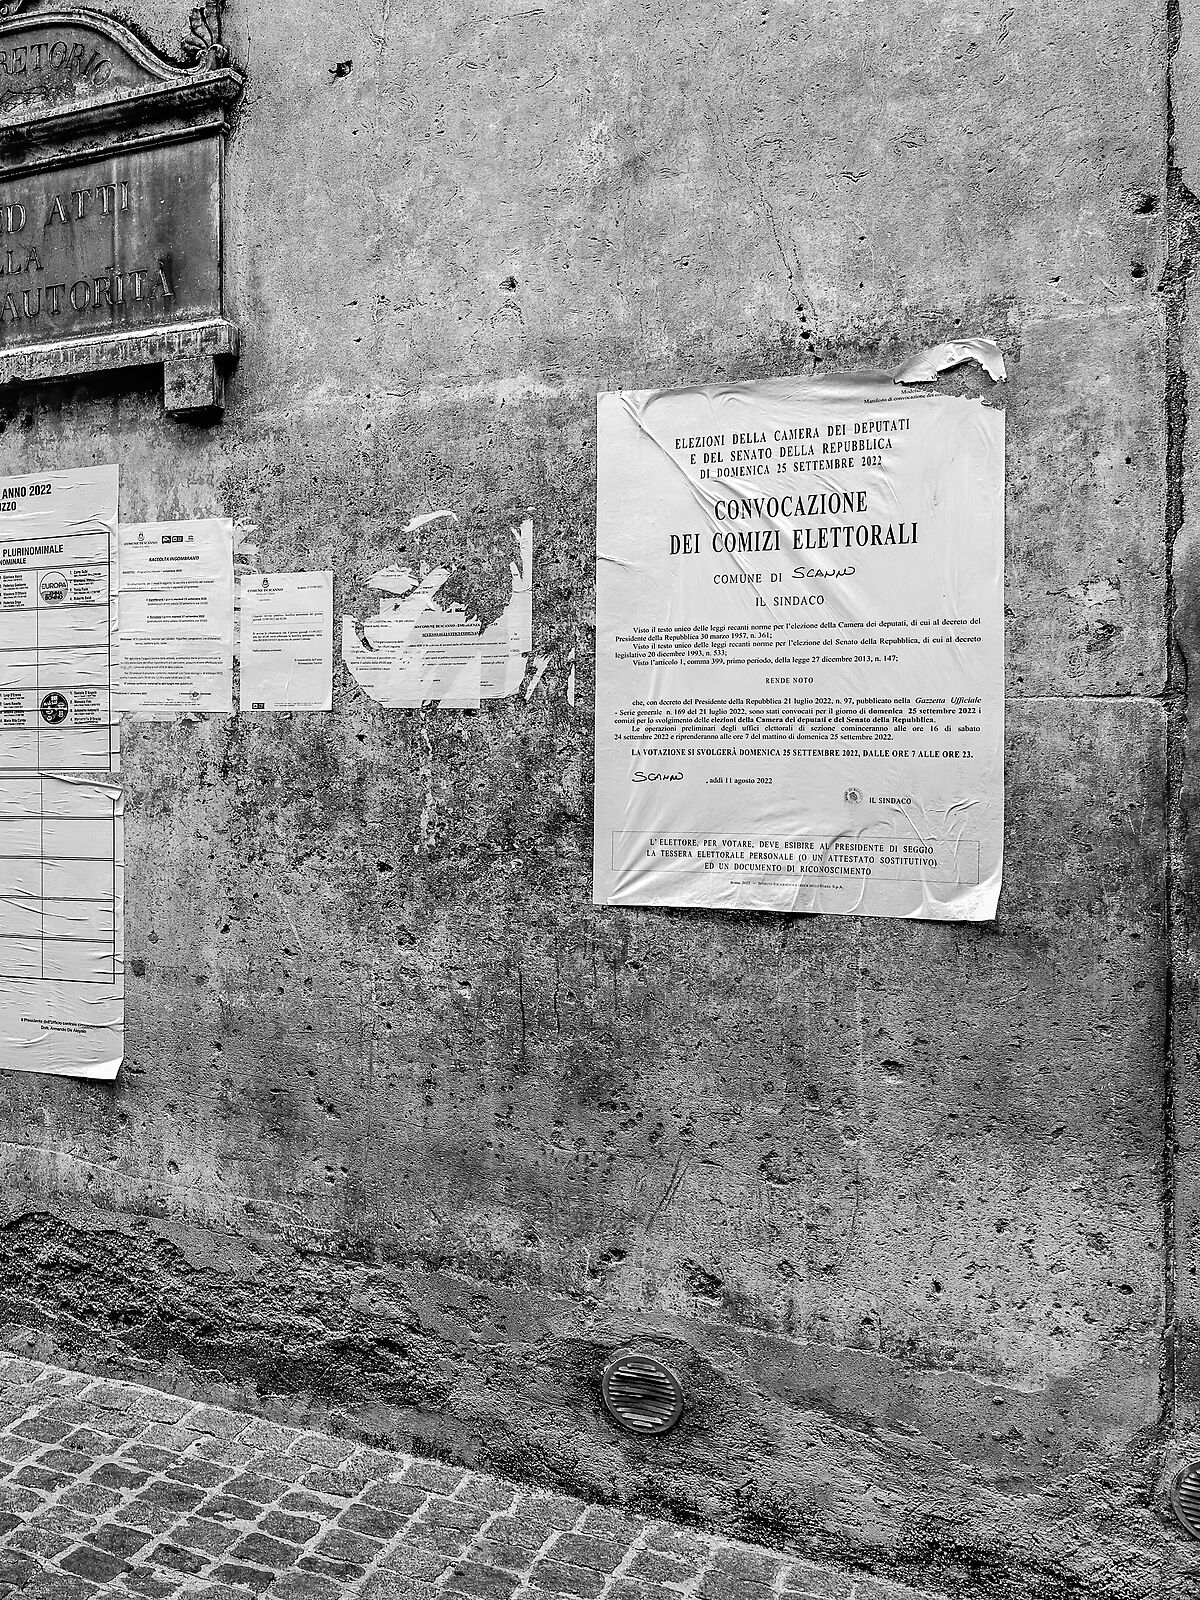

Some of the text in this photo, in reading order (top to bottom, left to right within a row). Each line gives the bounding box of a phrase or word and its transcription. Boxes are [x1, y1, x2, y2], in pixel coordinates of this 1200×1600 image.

[49, 181, 130, 225] ATTI
[675, 418, 909, 449] ELEZIONI DELLA CAMERA DEI DEPUTATI
[690, 437, 892, 464] E DEL SENATO DELLA REPUBBLICA
[700, 455, 882, 479] DI DOMENICA 25 SETTEMBRE 2022
[2, 486, 26, 499] ANNO
[29, 483, 52, 496] 2022
[712, 490, 867, 520] CONVOCAZIONE
[669, 522, 918, 555] DEI COMIZI ELETTORALI
[2, 544, 63, 557] PLURINOMINALE
[713, 572, 782, 584] COMUNE DI
[755, 594, 824, 606] IL SINDACO
[710, 624, 725, 632] leggi
[919, 618, 930, 626] cui
[631, 748, 641, 756] LA
[643, 748, 685, 756] VOTAZIONE
[696, 746, 737, 756] SVOLGERÀ
[739, 748, 780, 756] DOMENICA
[792, 748, 840, 756] SETTEMBRE
[863, 749, 889, 757] DALLE
[891, 749, 909, 757] ORE
[942, 750, 960, 758] ORE
[962, 750, 973, 758] 23.
[759, 840, 779, 848] DEVE
[784, 841, 814, 850] ESIBIRE
[819, 843, 829, 851] AL
[832, 842, 884, 852] PRESIDENTE
[889, 844, 897, 852] DI
[902, 842, 933, 854] SEGGIO
[660, 849, 692, 857] TESSERA
[697, 850, 744, 862] ELETTORALE
[749, 852, 793, 860] PERSONALE
[812, 854, 824, 862] UN
[827, 854, 874, 863] ATTESTATO
[734, 862, 782, 874] DOCUMENTO
[786, 864, 794, 872] DI
[800, 863, 871, 875] RICONOSCIMENTO
